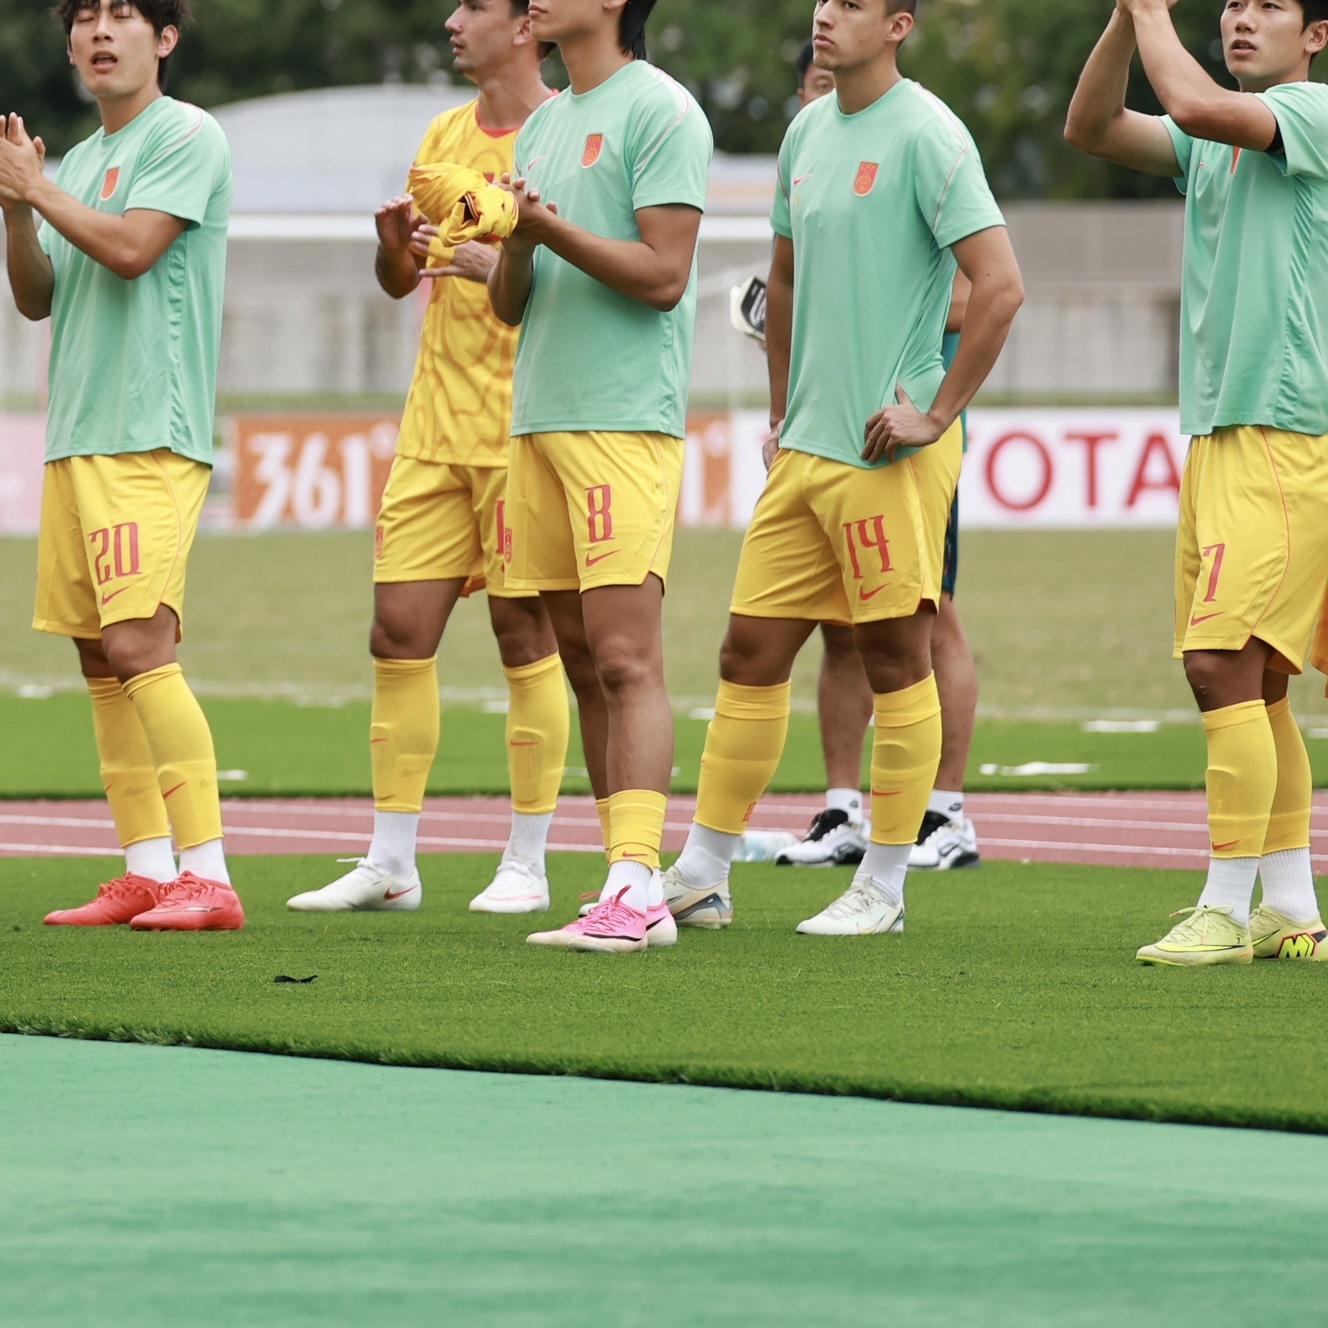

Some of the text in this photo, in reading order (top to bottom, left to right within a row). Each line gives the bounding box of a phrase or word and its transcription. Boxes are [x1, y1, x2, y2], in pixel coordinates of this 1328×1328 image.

[584, 484, 617, 543] 8
[88, 521, 143, 587] 20
[842, 514, 895, 580] 14
[1202, 542, 1226, 603] 7
